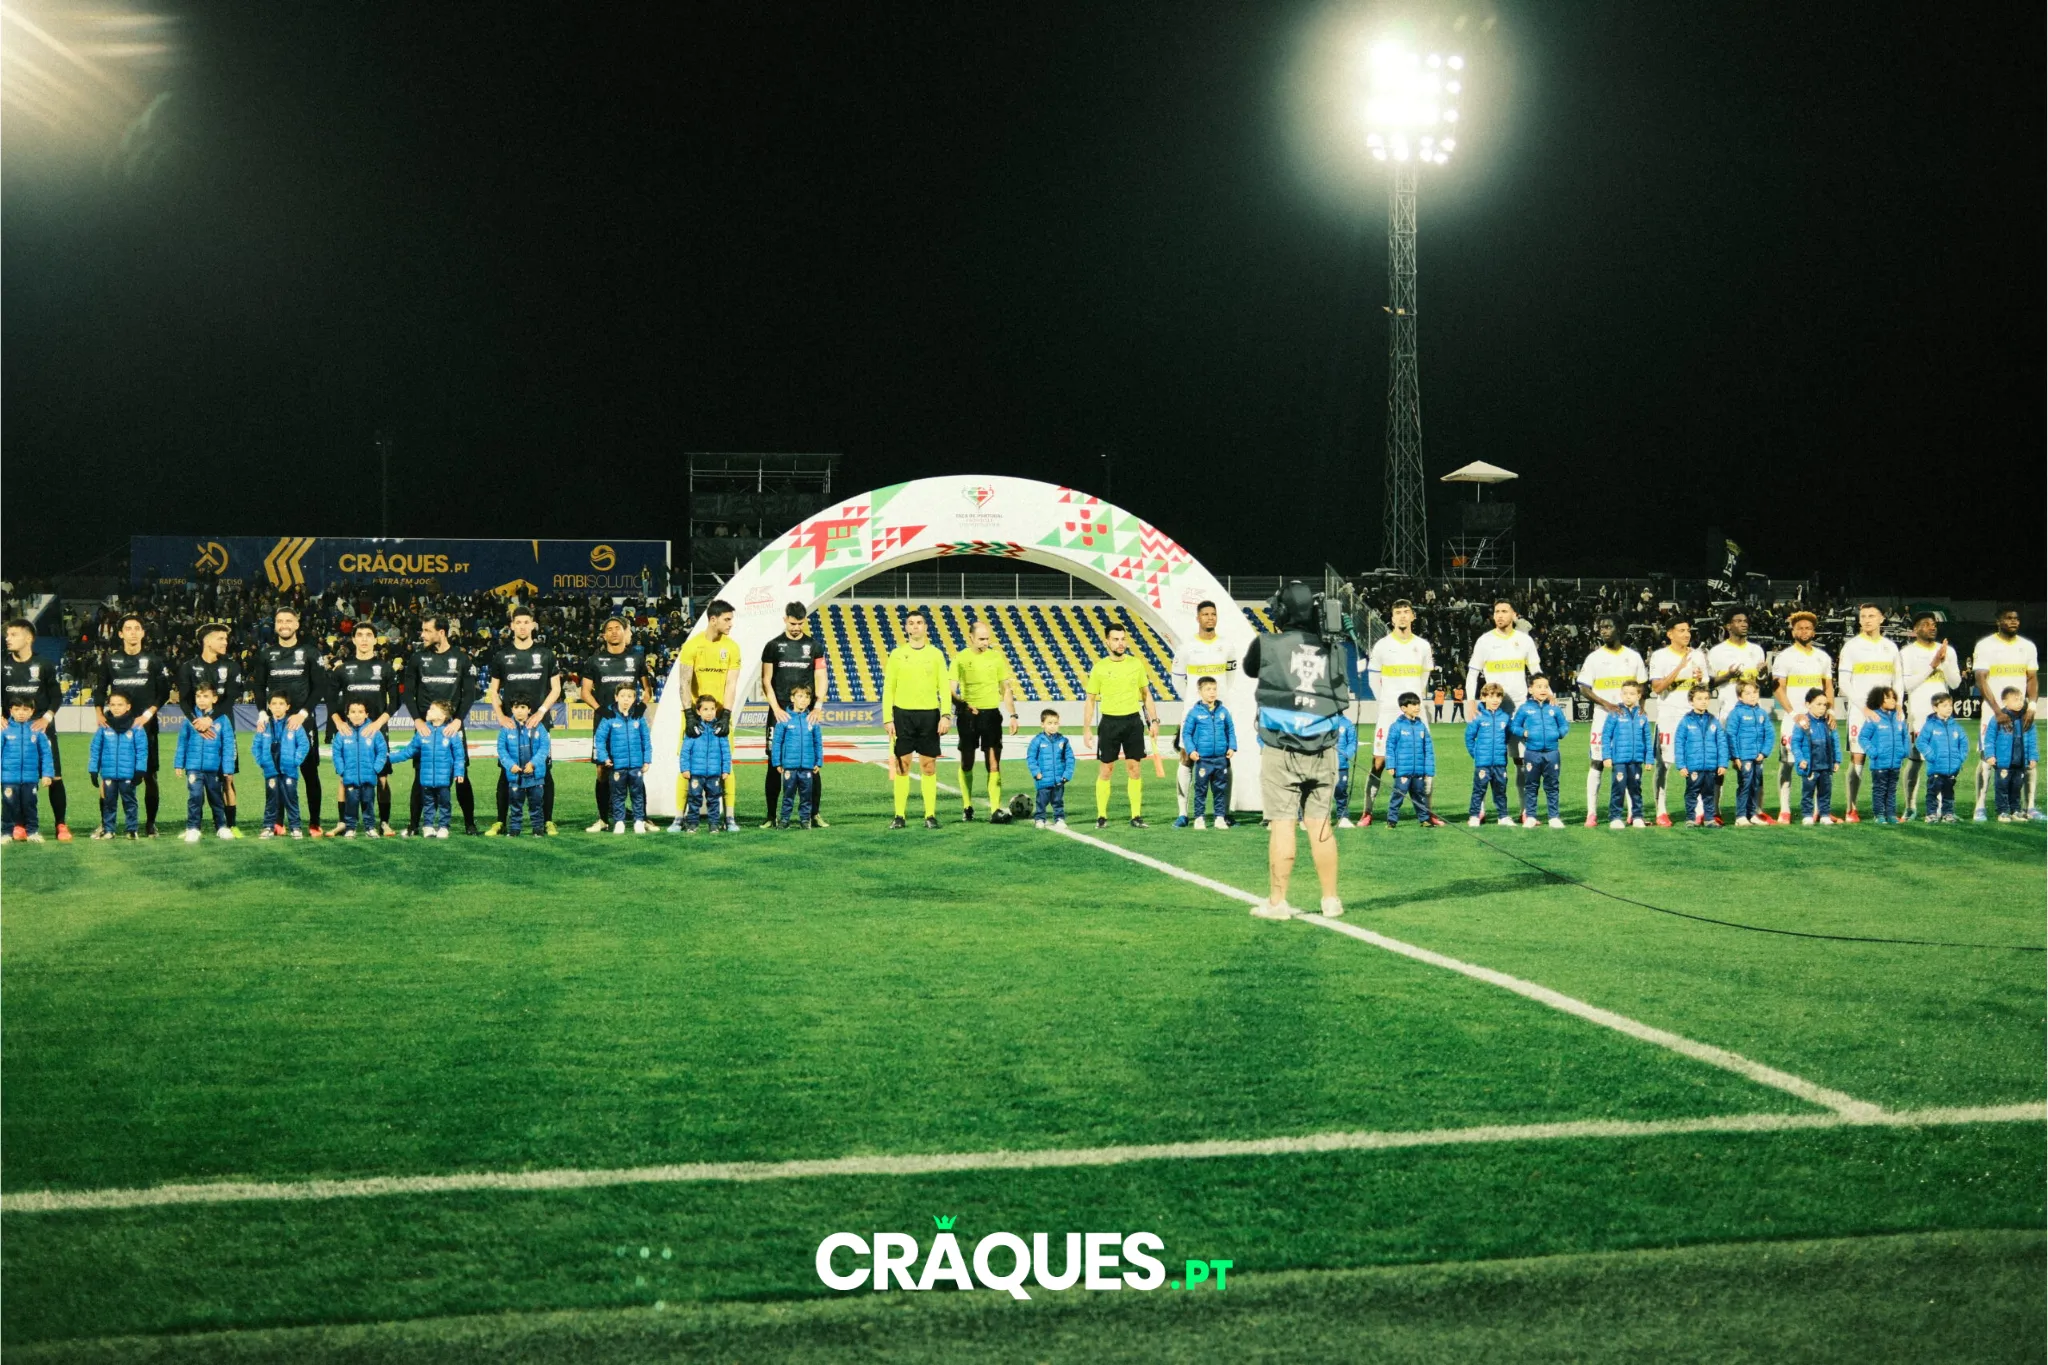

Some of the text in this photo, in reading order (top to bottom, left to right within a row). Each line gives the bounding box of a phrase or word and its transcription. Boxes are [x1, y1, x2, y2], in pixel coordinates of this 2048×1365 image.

[1954, 699, 1981, 718] egr
[819, 710, 874, 722] ECNIFEX
[1376, 728, 1383, 740] 4
[1850, 725, 1858, 737] 8
